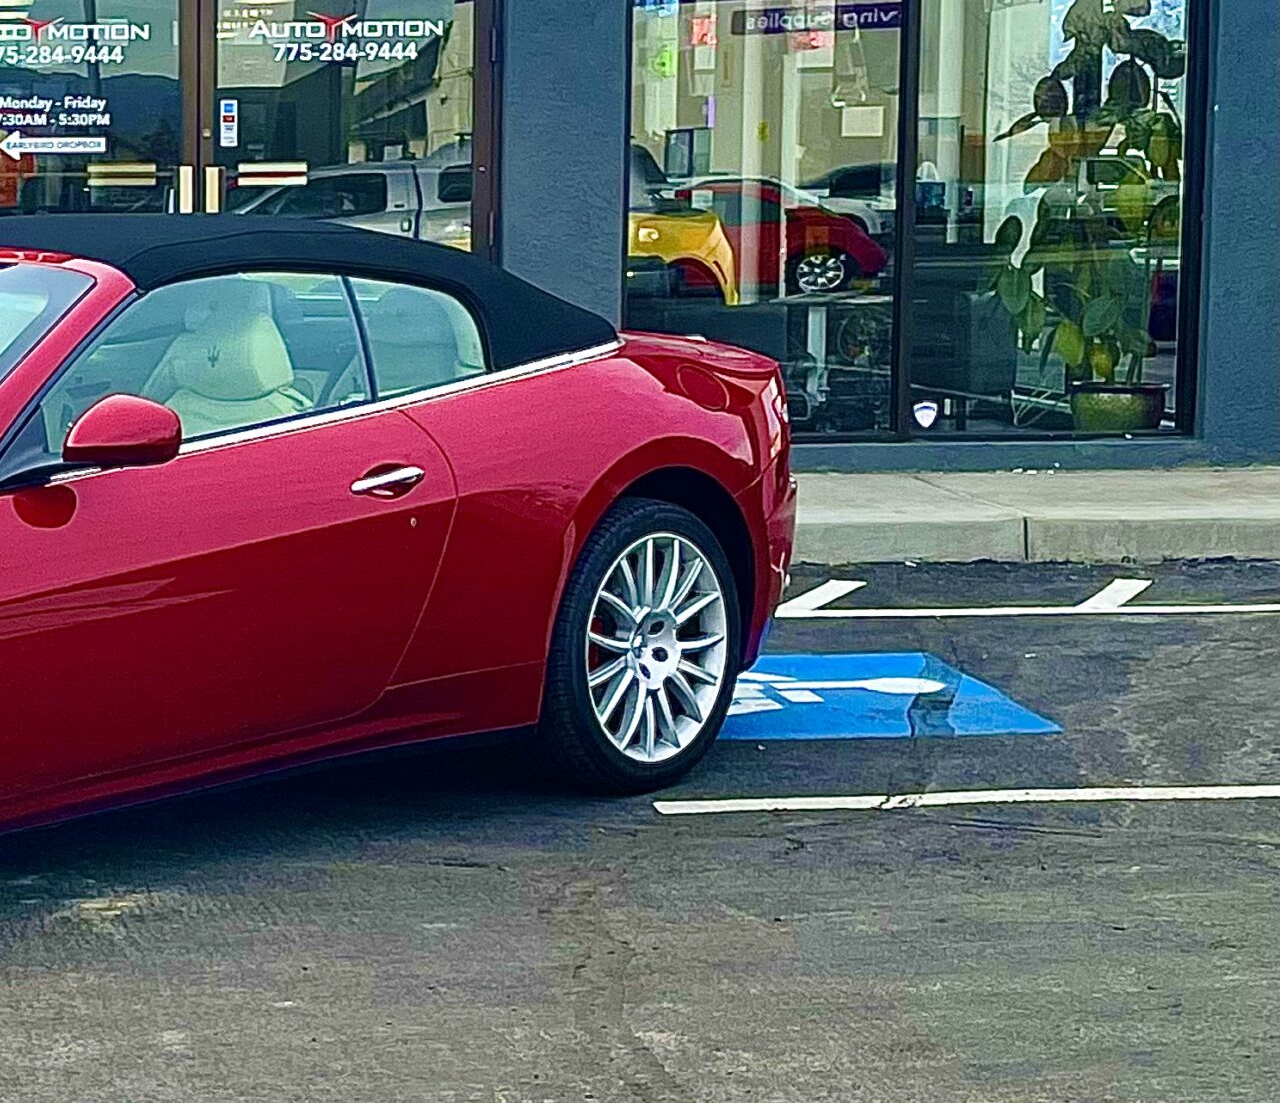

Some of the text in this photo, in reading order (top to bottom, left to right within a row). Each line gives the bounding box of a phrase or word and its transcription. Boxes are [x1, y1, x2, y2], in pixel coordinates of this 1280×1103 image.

[47, 23, 150, 40] MOTION
[248, 19, 444, 38] AUTO MOTION
[273, 42, 418, 62] 775-284-9444
[64, 96, 107, 111] Friday
[58, 113, 111, 126] 5:30PM
